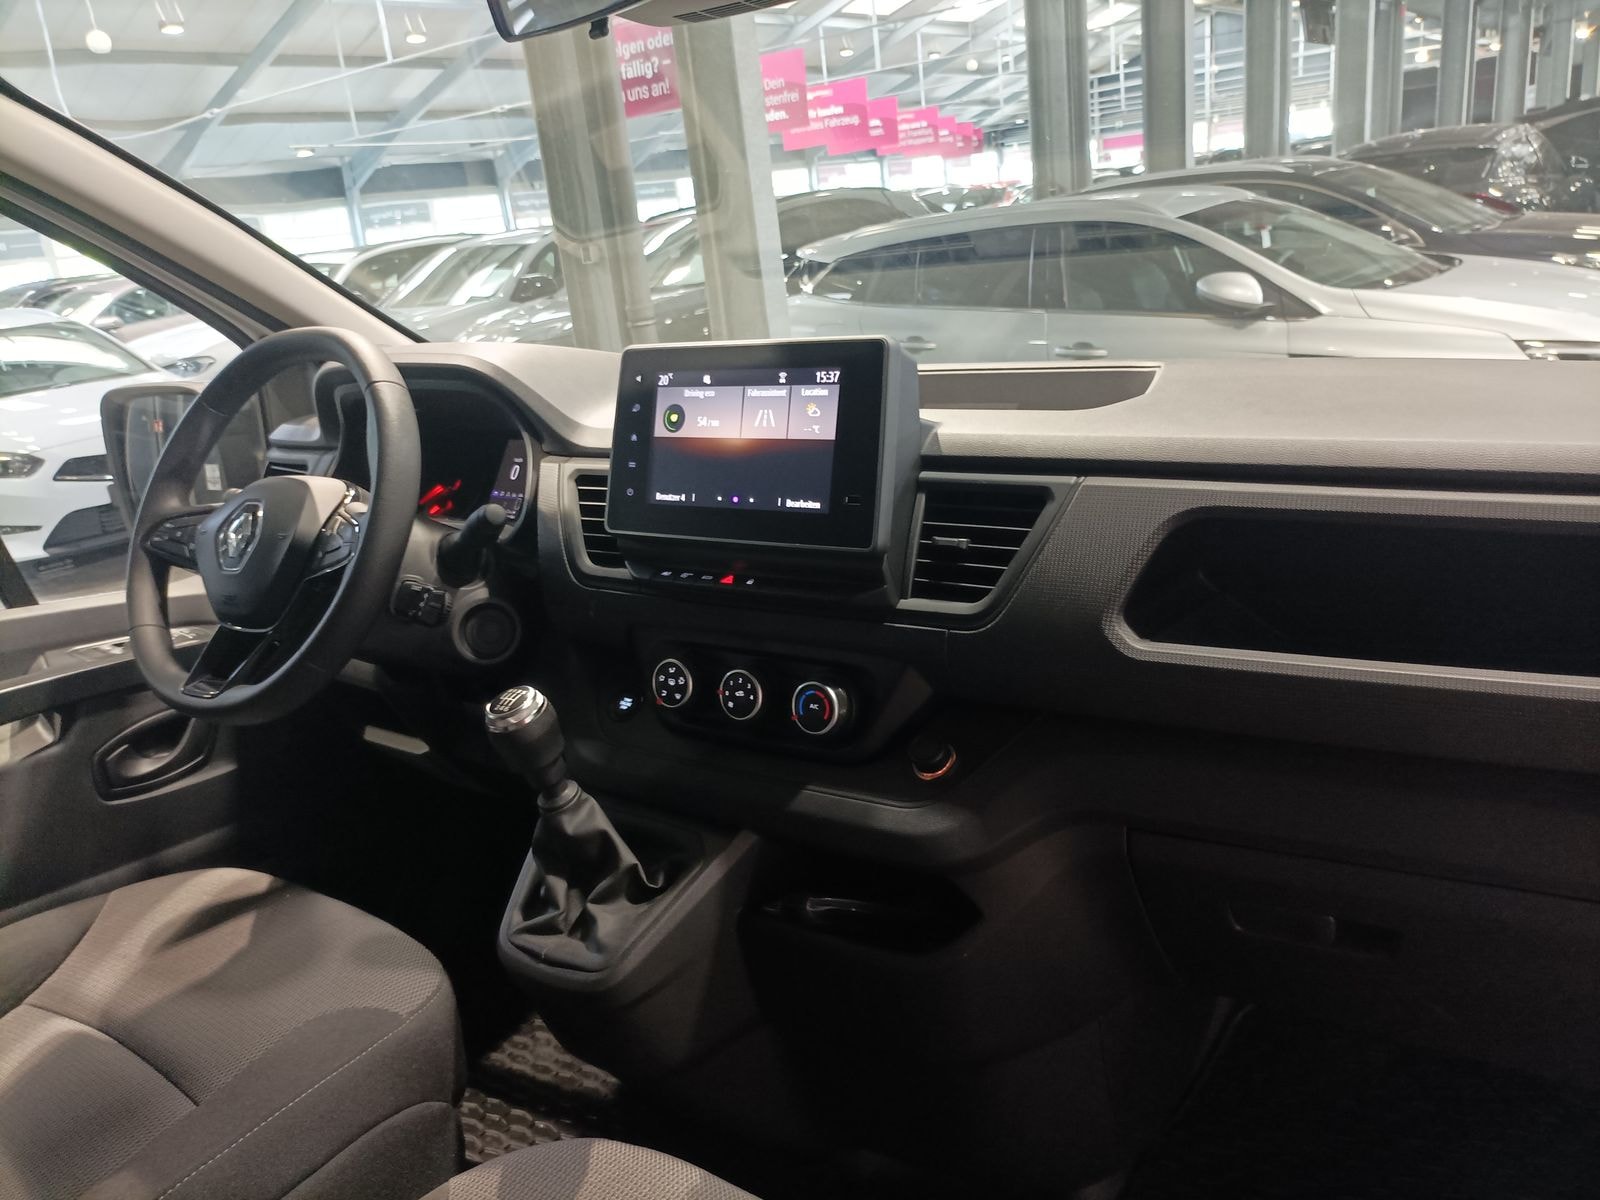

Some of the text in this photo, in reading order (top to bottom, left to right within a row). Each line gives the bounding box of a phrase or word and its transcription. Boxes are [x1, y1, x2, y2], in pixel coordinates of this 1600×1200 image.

[620, 56, 659, 80] fällig?
[627, 85, 650, 102] uns
[651, 77, 671, 97] an!
[815, 370, 841, 383] 15:37
[801, 387, 829, 397] Location
[510, 464, 520, 480] 0
